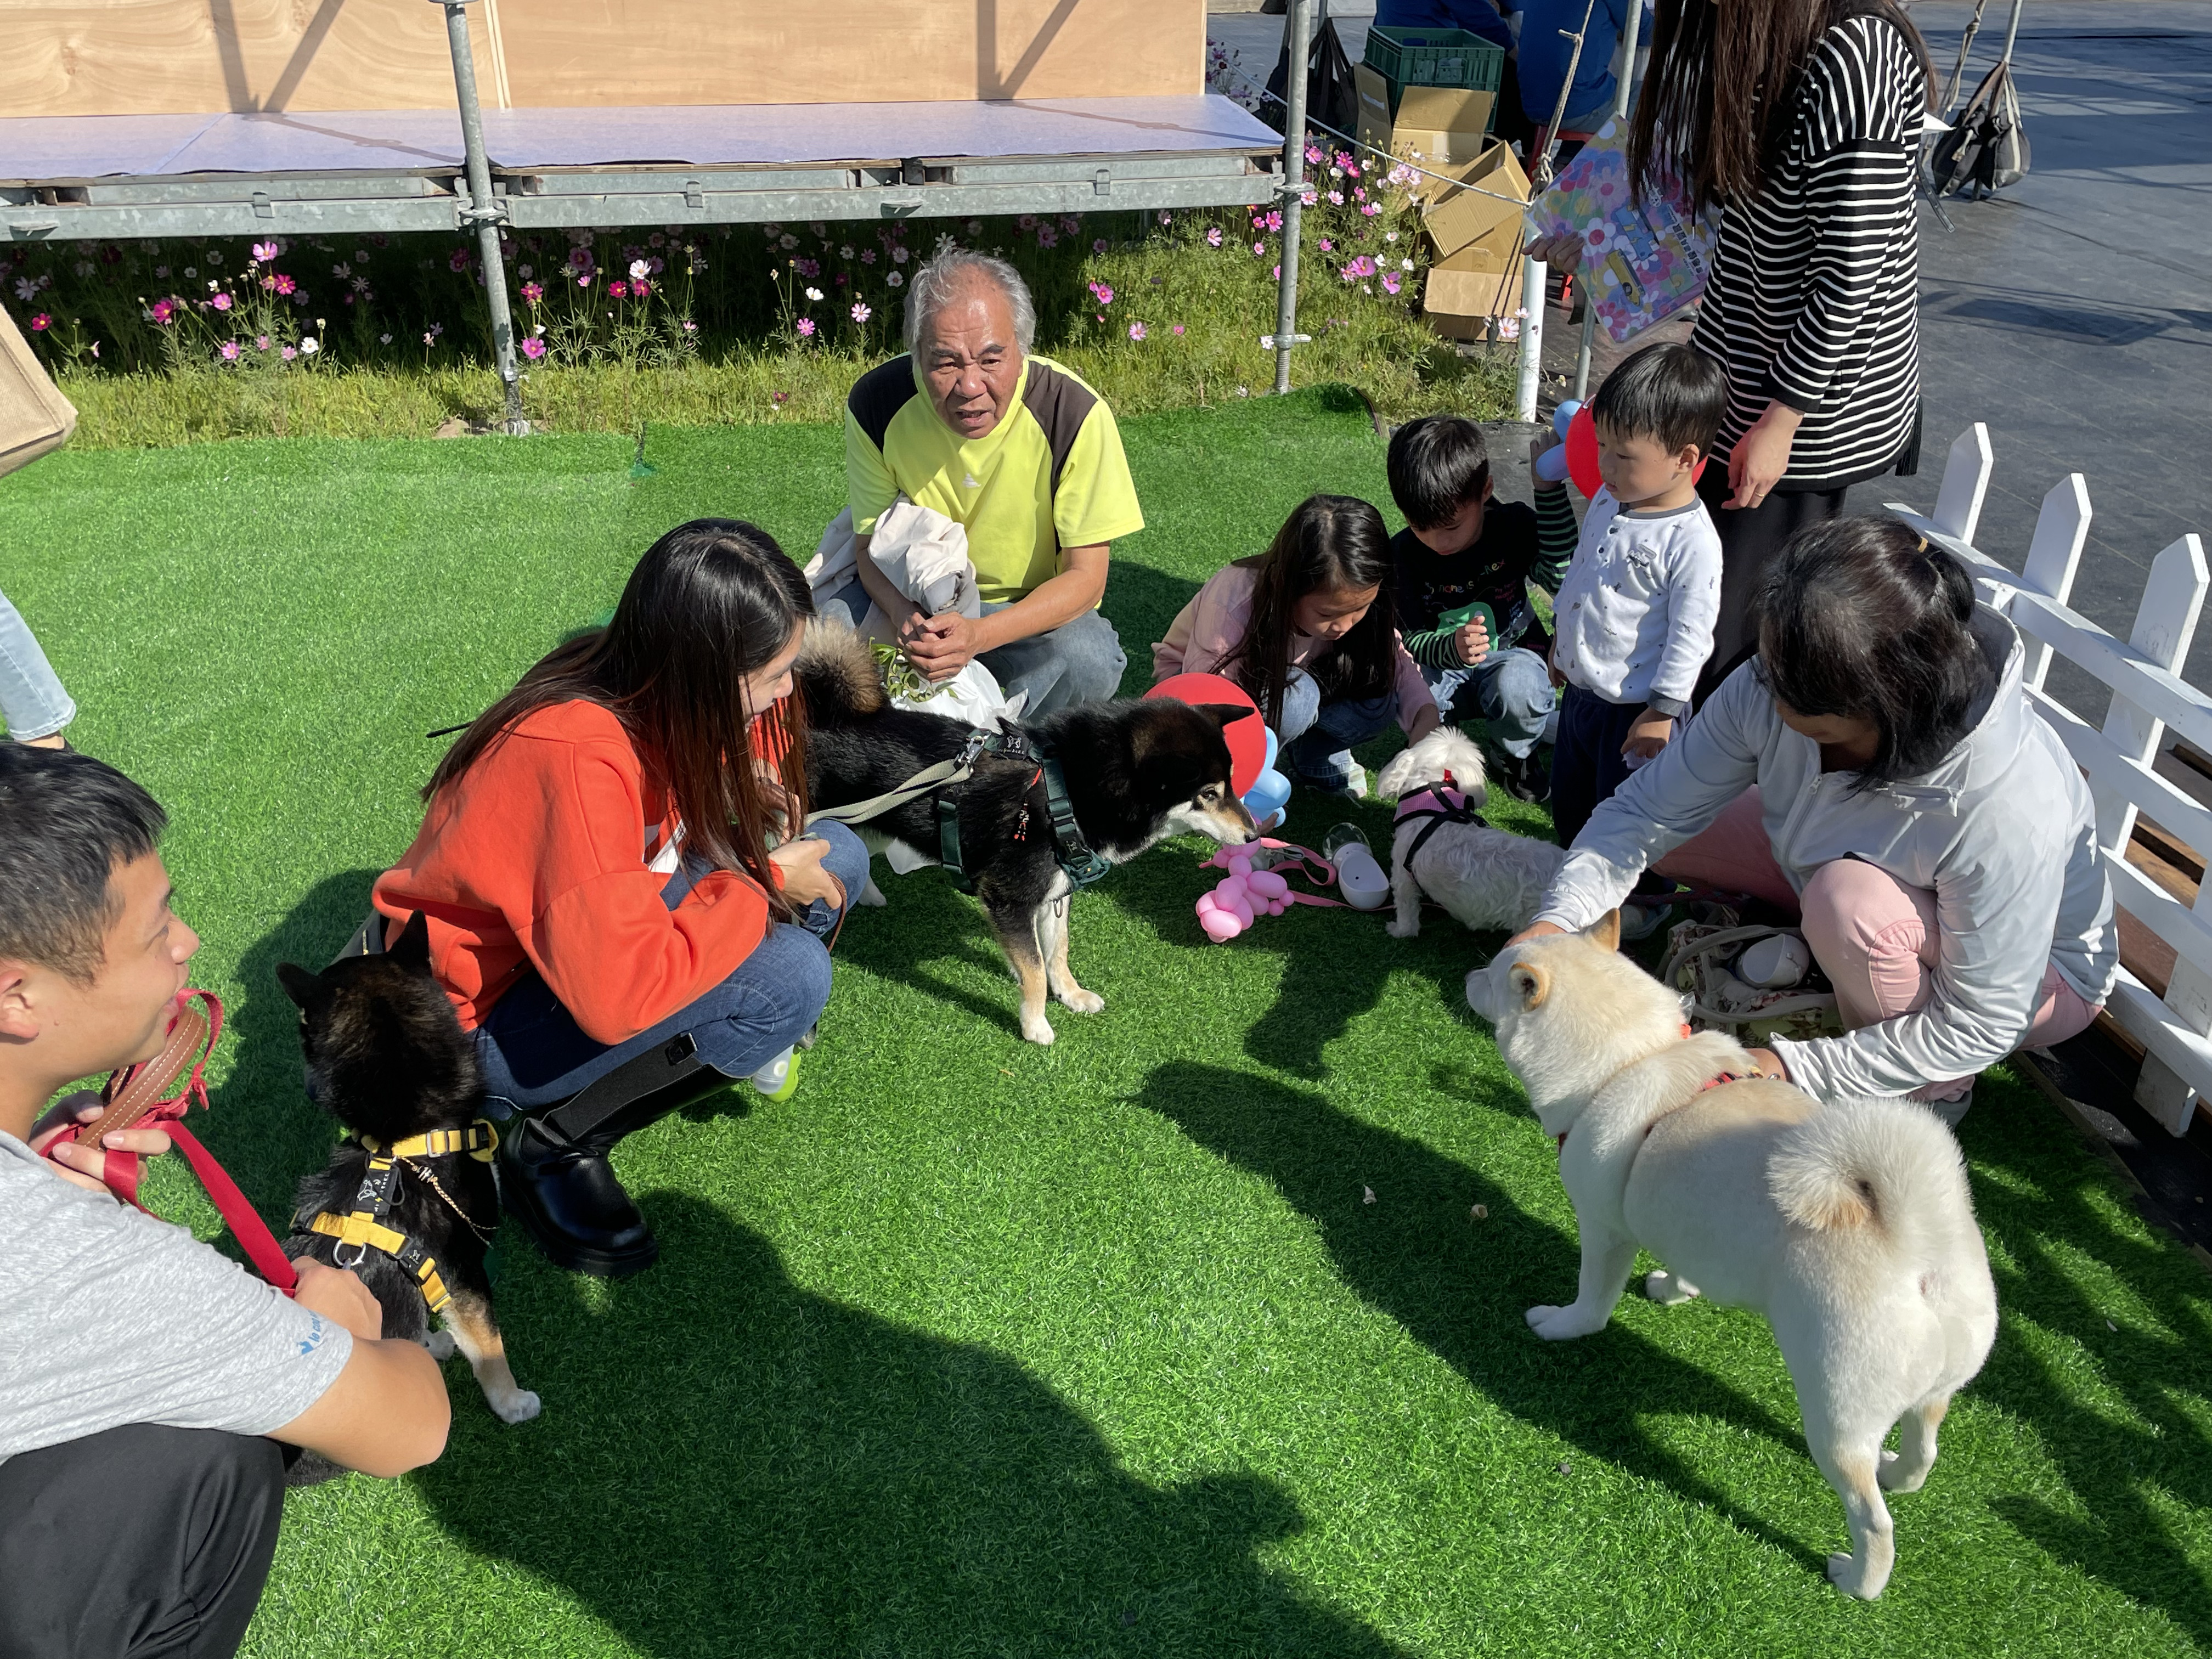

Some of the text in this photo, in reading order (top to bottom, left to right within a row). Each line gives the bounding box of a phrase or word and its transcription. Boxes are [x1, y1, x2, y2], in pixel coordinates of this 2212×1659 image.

[1439, 584, 1464, 593] name
[1478, 559, 1506, 581] -Rex
[308, 1332, 320, 1342] le
